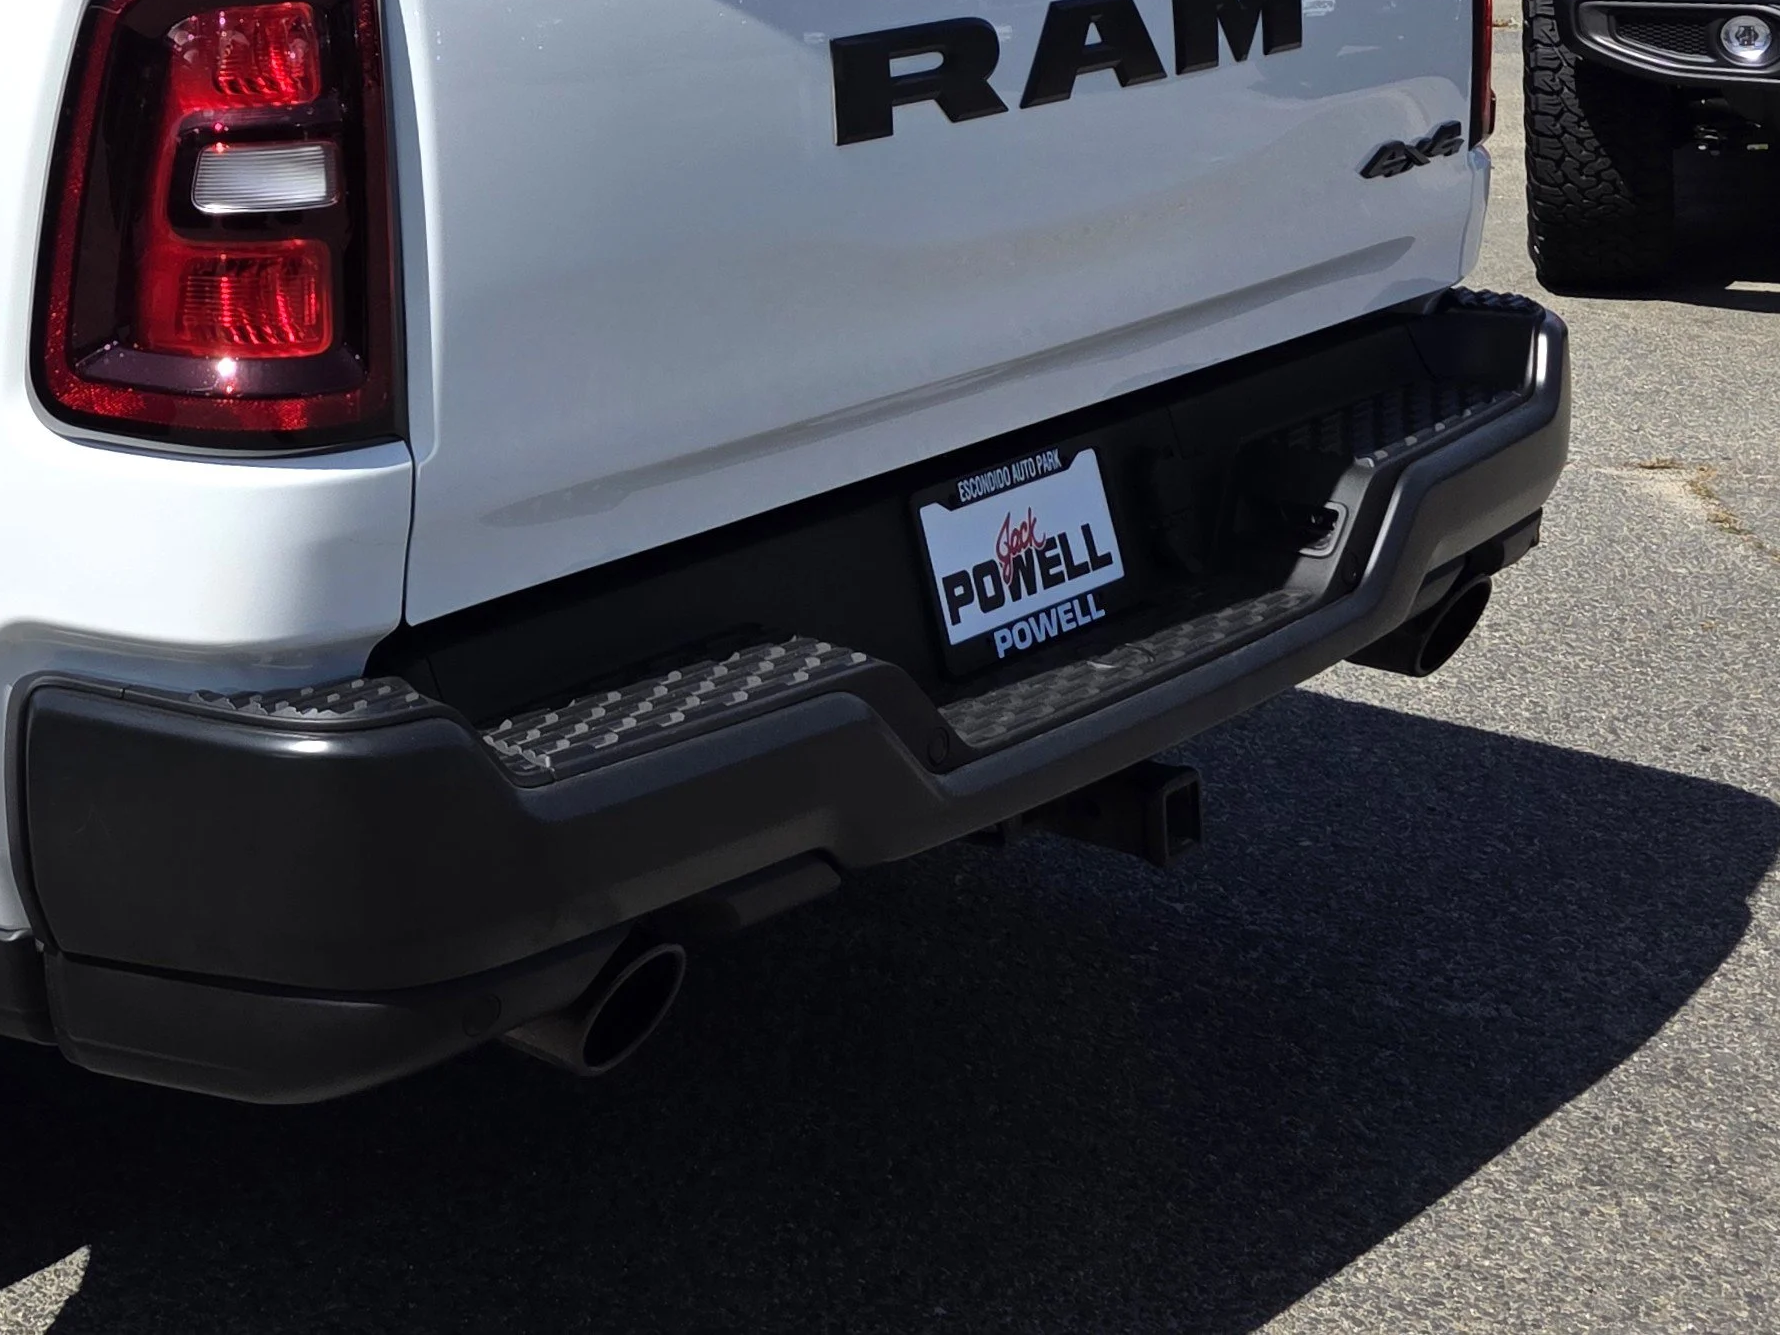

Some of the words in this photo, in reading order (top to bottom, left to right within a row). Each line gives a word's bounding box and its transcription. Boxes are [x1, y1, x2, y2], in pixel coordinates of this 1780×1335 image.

[957, 467, 1011, 502] ESCONDIDO
[1011, 457, 1037, 484] AUTO
[1035, 448, 1062, 475] PARK
[941, 523, 1114, 627] POWELL
[995, 506, 1046, 587] Jack
[993, 592, 1106, 659] POWELL
